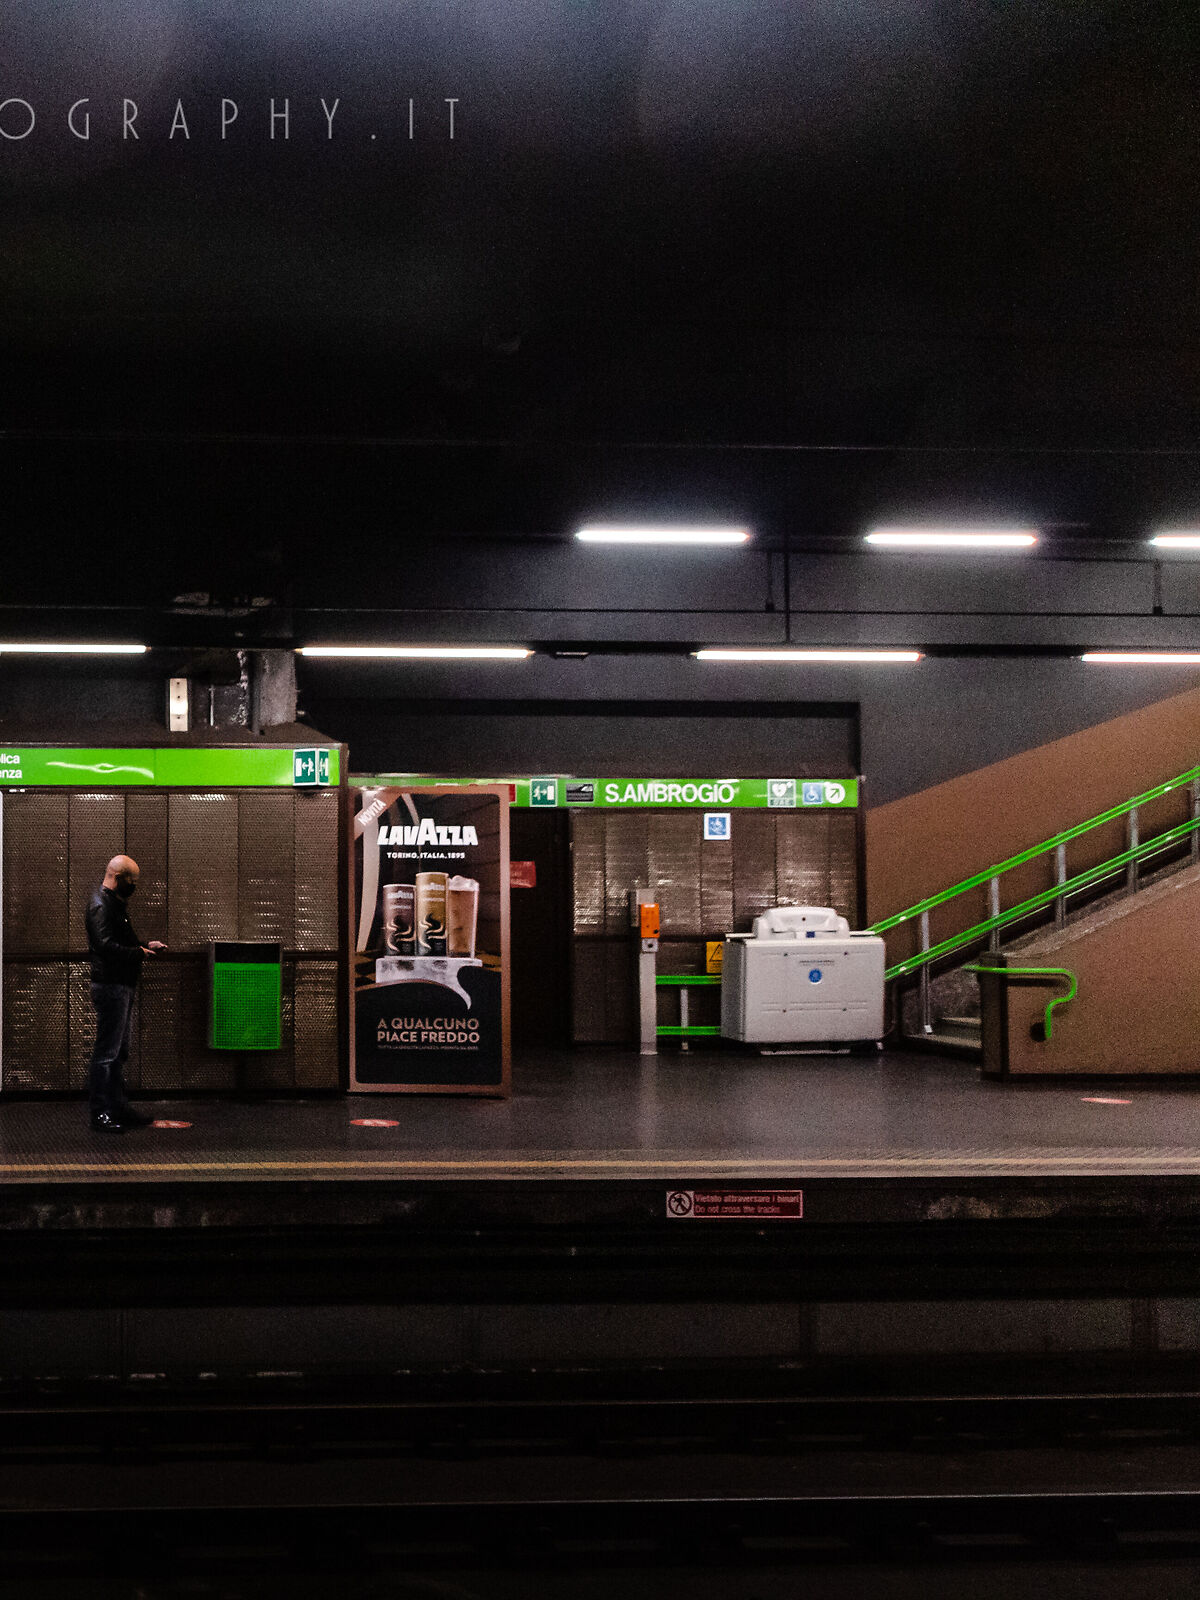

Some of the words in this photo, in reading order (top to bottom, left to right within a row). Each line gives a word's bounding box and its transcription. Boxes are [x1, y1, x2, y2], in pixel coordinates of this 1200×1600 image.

[605, 783, 735, 803] S.AMBROGIO
[376, 818, 479, 846] LAVAZZA
[377, 1018, 388, 1030] A
[391, 1018, 480, 1030] QUALCUNO
[377, 1031, 418, 1042] PIACE
[421, 1031, 480, 1043] FREDDO
